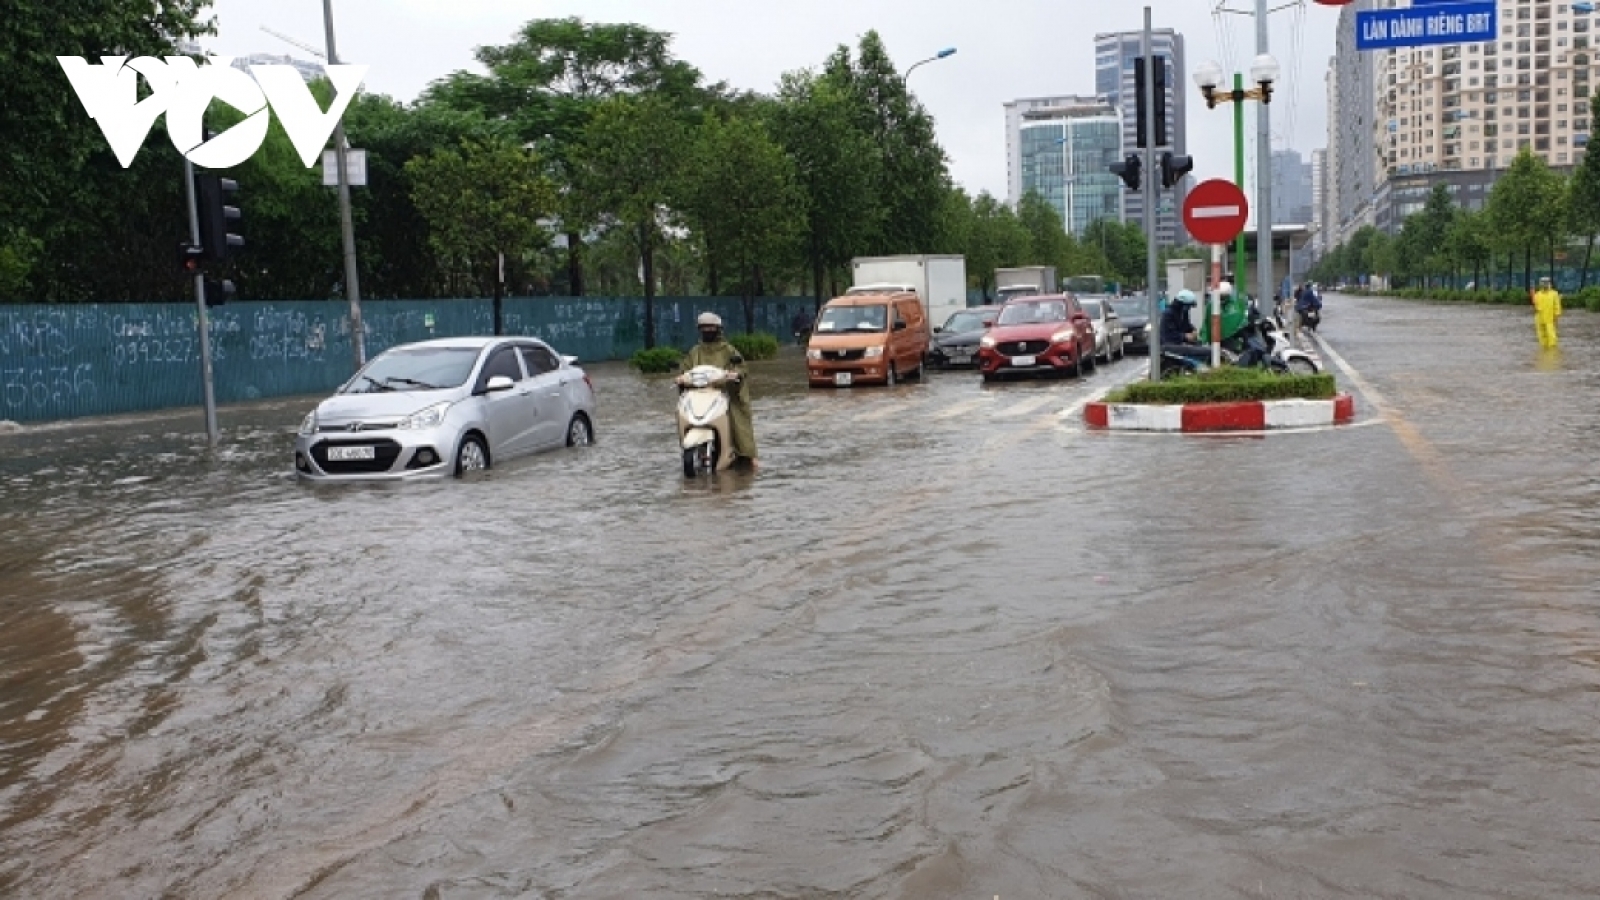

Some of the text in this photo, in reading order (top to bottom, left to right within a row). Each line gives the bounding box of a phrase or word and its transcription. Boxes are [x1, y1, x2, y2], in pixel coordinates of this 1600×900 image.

[1363, 11, 1491, 41] LÀN DÀNH RIÊNG BRT
